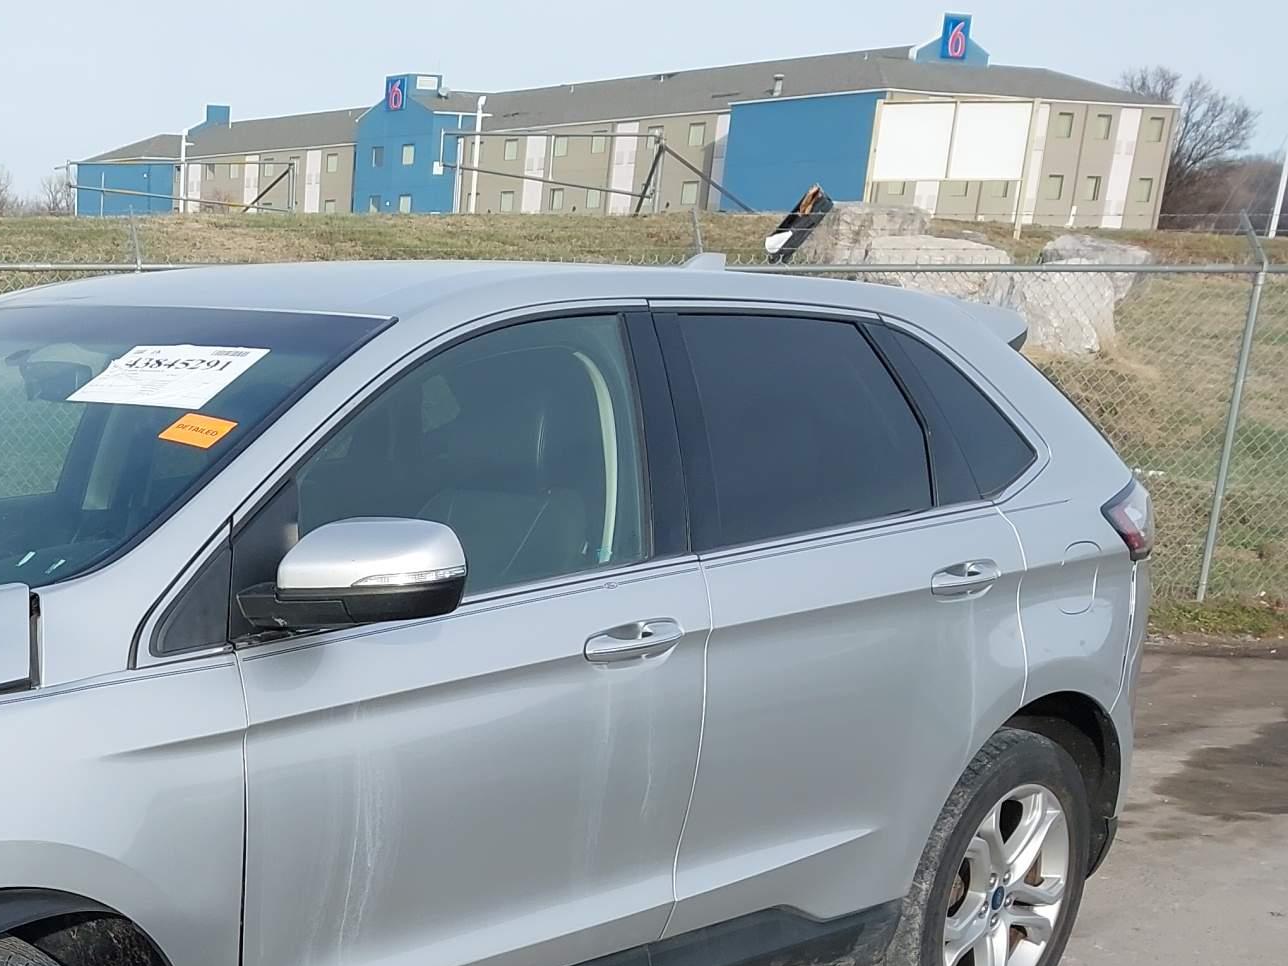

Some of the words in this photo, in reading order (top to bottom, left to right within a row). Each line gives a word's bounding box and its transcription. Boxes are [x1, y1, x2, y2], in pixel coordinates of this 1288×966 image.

[948, 21, 966, 58] 6
[389, 79, 403, 110] 6
[125, 357, 232, 371] 43845291
[176, 423, 218, 437] DETAILED
